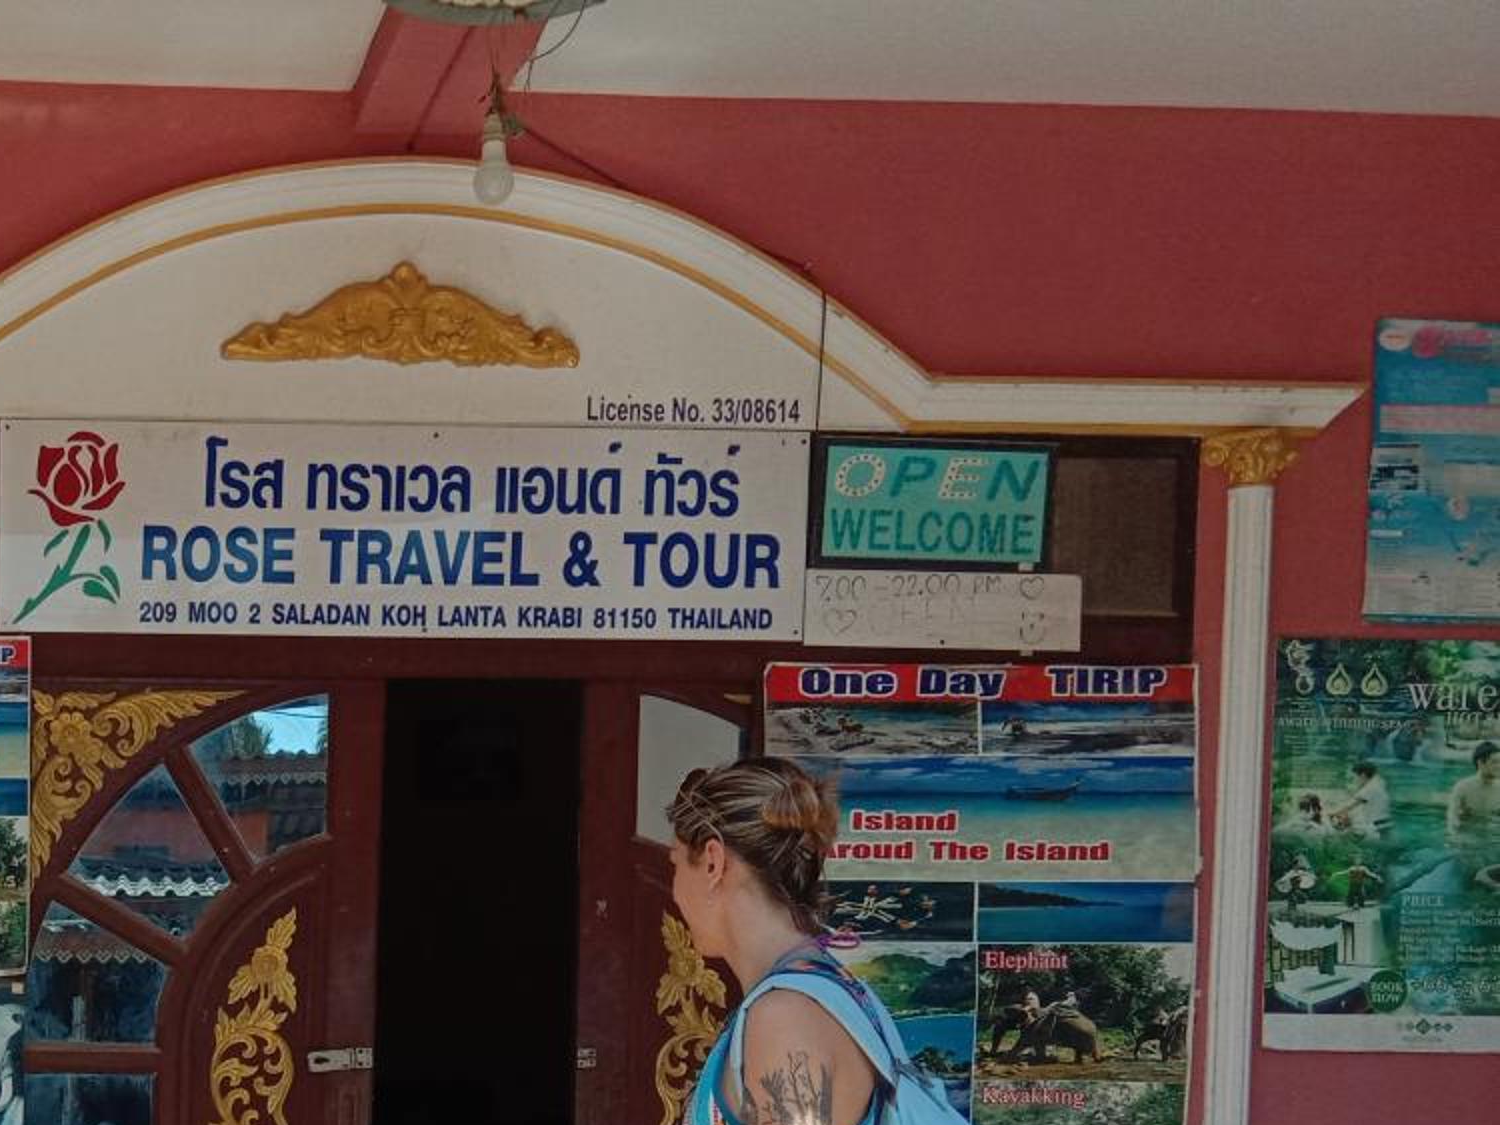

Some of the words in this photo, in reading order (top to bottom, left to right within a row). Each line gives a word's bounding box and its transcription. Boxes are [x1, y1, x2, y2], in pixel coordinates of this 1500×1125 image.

[587, 397, 665, 423] License
[672, 398, 705, 423] No.
[712, 399, 801, 424] 33/08614
[205, 435, 285, 510] โรส
[306, 458, 472, 514] ทราเวล
[494, 441, 623, 515] แอนด์
[643, 443, 743, 518] ทัวร์
[835, 453, 1041, 501] OPEN
[830, 507, 1036, 555] WELCOME
[140, 524, 297, 585] ROSE
[319, 527, 541, 588] TRAVEL
[562, 531, 600, 588] &
[623, 532, 782, 590] TOUR
[139, 602, 178, 625] 209
[187, 602, 238, 626] MOO
[248, 603, 262, 626] 2
[271, 603, 371, 627] SALADAN
[381, 605, 427, 628] KOH
[437, 606, 506, 628] LANTA
[517, 606, 583, 629] KRABI
[592, 608, 658, 630] 81150
[667, 608, 774, 631] THAILAND
[800, 669, 897, 696] One
[917, 668, 1006, 698] Day
[1045, 667, 1167, 696] TIRIP
[852, 811, 957, 831] Island
[930, 841, 990, 862] The
[1004, 841, 1111, 862] Island
[984, 950, 1069, 971] Elephant
